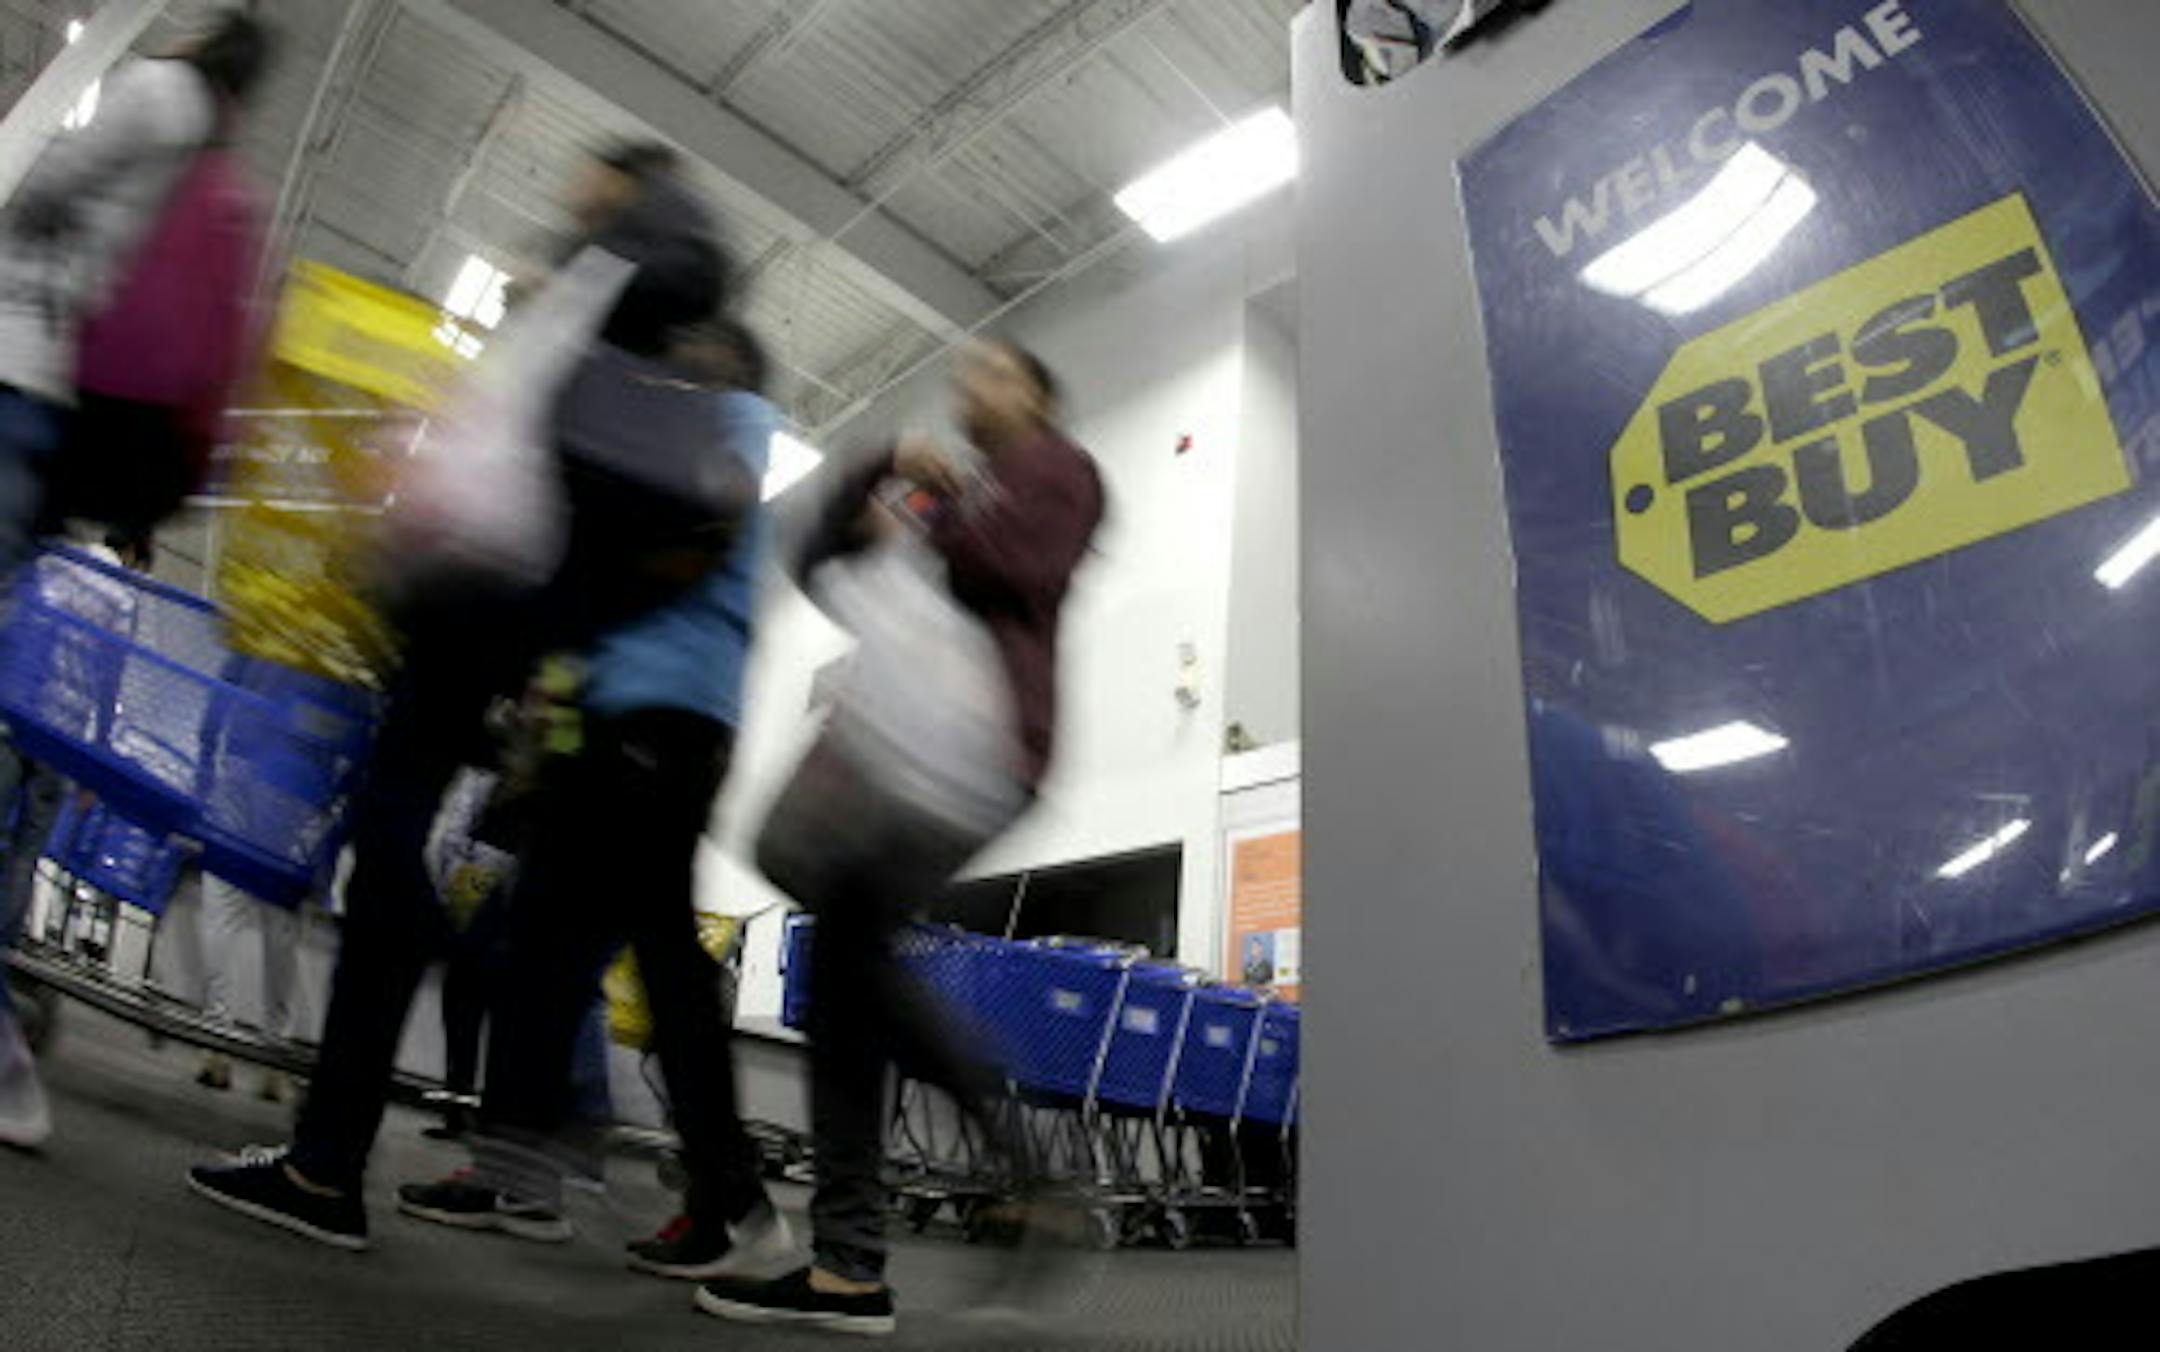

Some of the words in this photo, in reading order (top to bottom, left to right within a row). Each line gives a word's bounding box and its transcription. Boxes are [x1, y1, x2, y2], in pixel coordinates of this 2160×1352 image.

[1534, 0, 1922, 257] WELCOME
[1657, 246, 2044, 486] BEST
[1685, 353, 2040, 579] BUY
